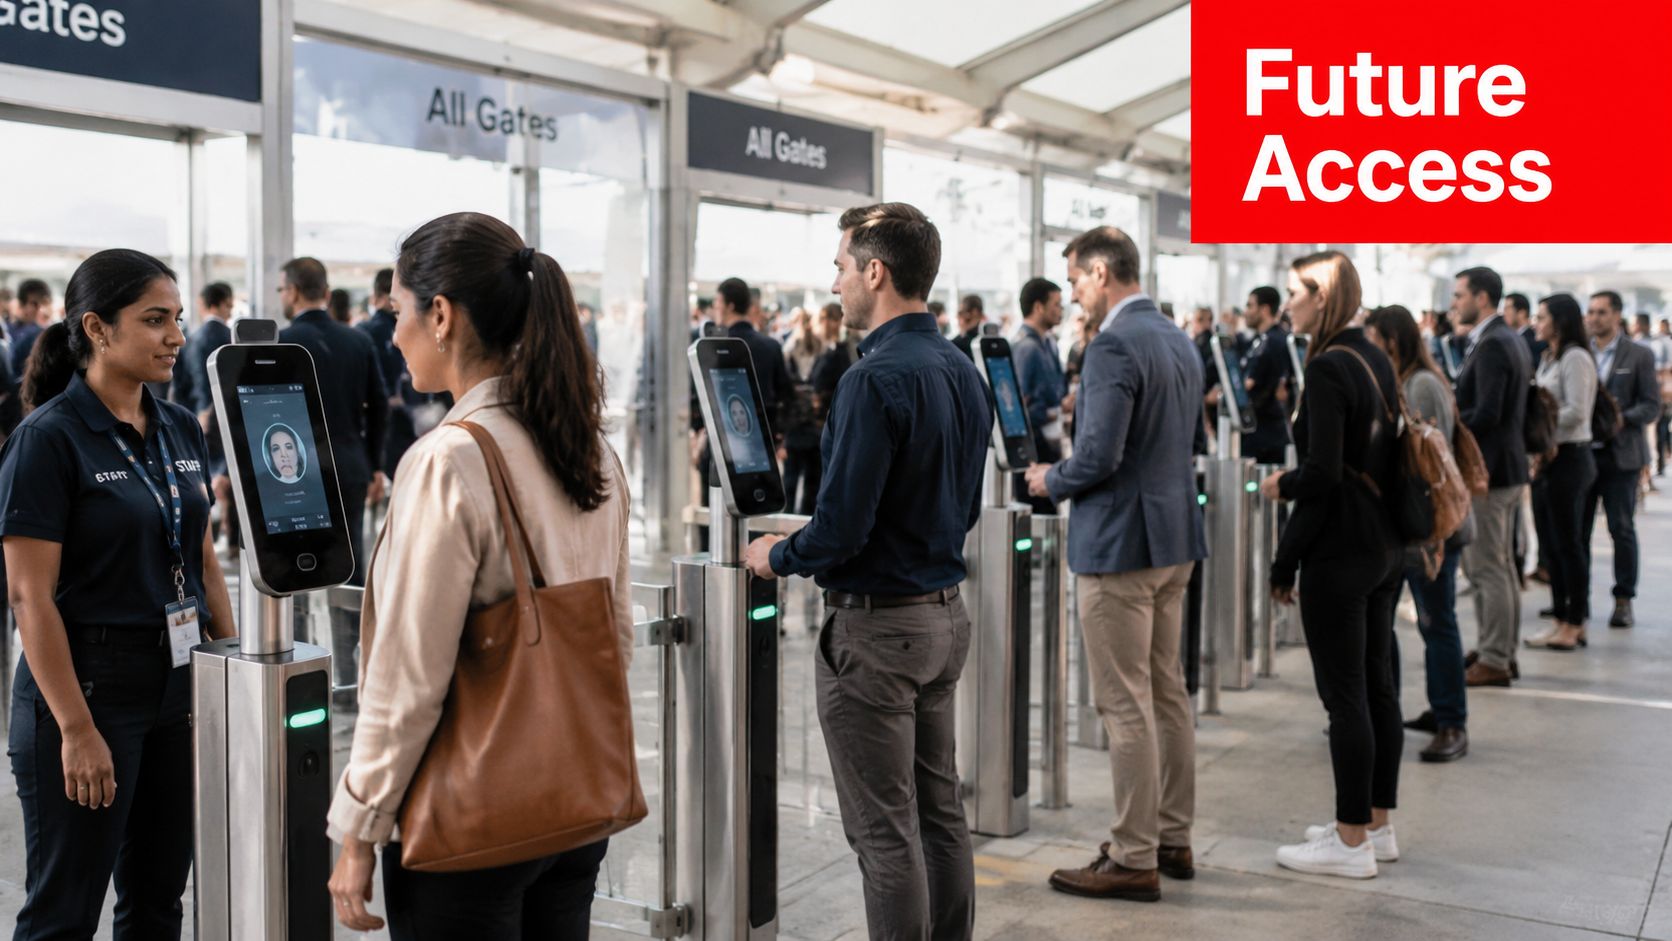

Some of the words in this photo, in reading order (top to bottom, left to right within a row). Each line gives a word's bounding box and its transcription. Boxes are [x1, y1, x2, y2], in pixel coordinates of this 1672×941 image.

[425, 86, 466, 127] All
[476, 95, 557, 142] Gates
[745, 126, 772, 160] All
[775, 131, 827, 169] Gates
